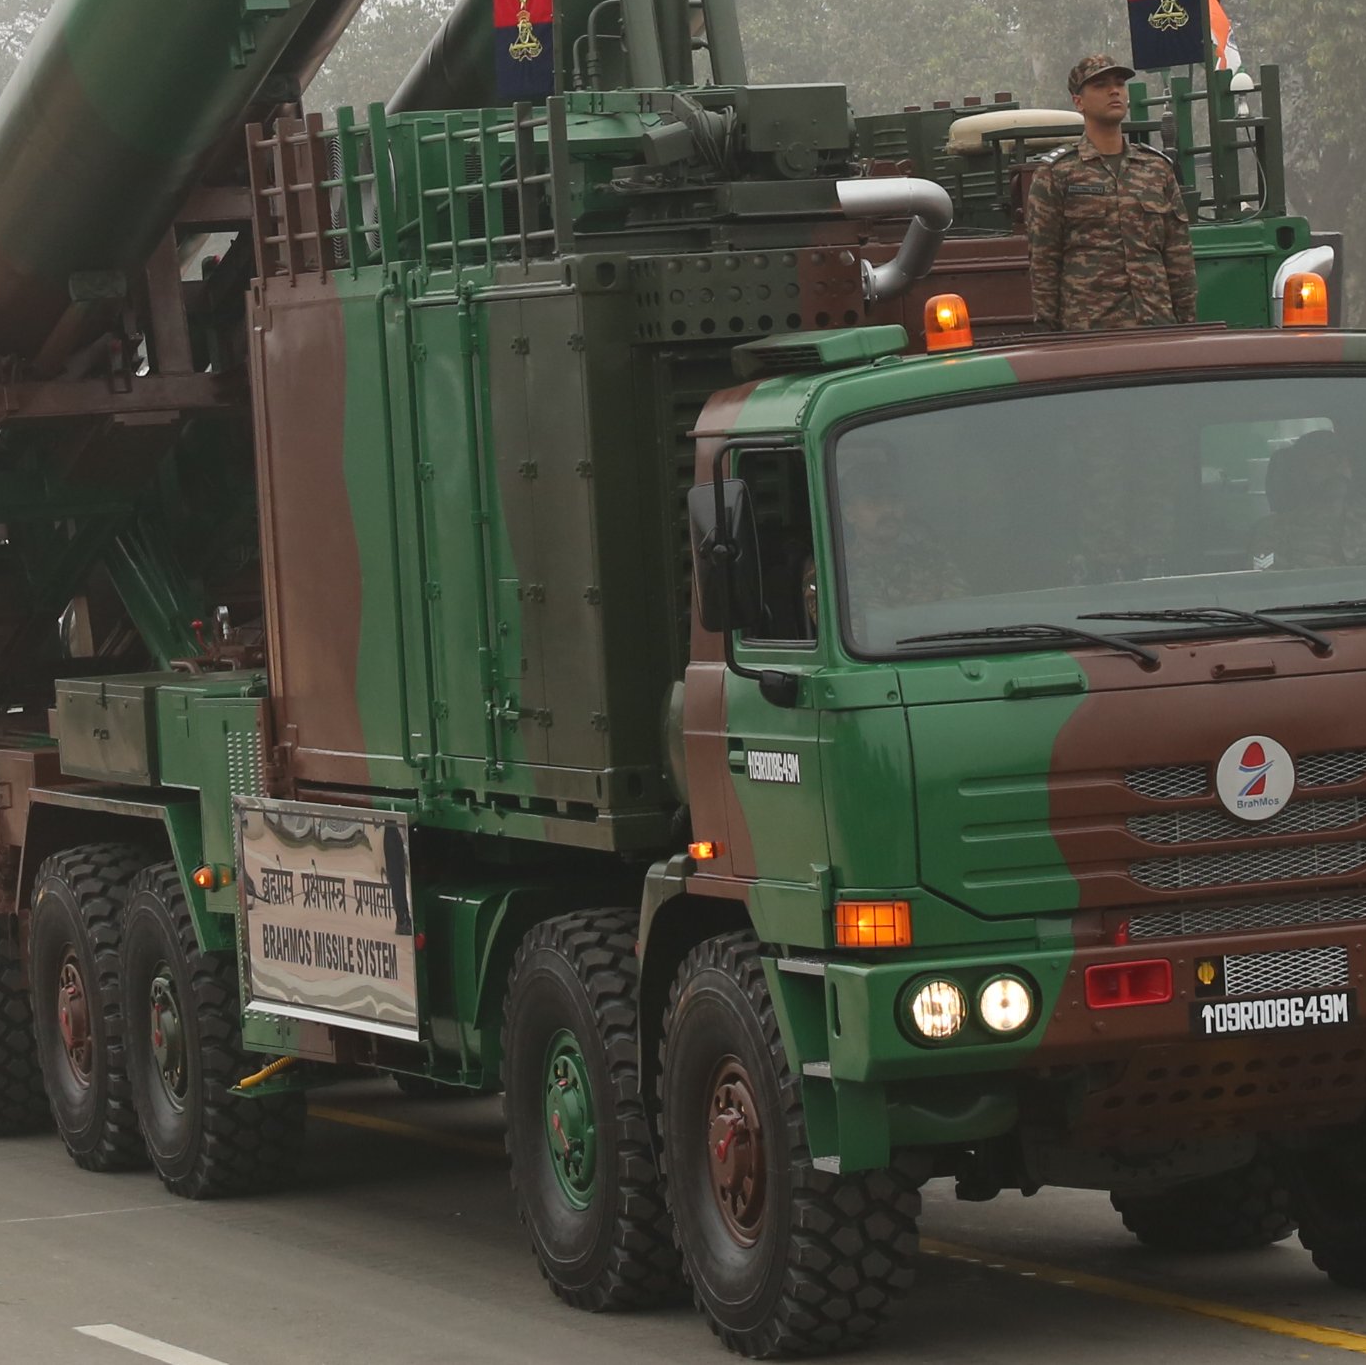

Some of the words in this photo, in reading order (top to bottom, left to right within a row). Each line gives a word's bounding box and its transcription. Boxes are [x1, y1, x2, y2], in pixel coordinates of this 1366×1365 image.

[1237, 798, 1280, 809] BrahMos
[263, 923, 312, 967] BRAHMOS
[314, 931, 355, 974] MISSILE
[356, 937, 398, 981] SYSTEM
[1215, 994, 1349, 1033] 09R008649M
